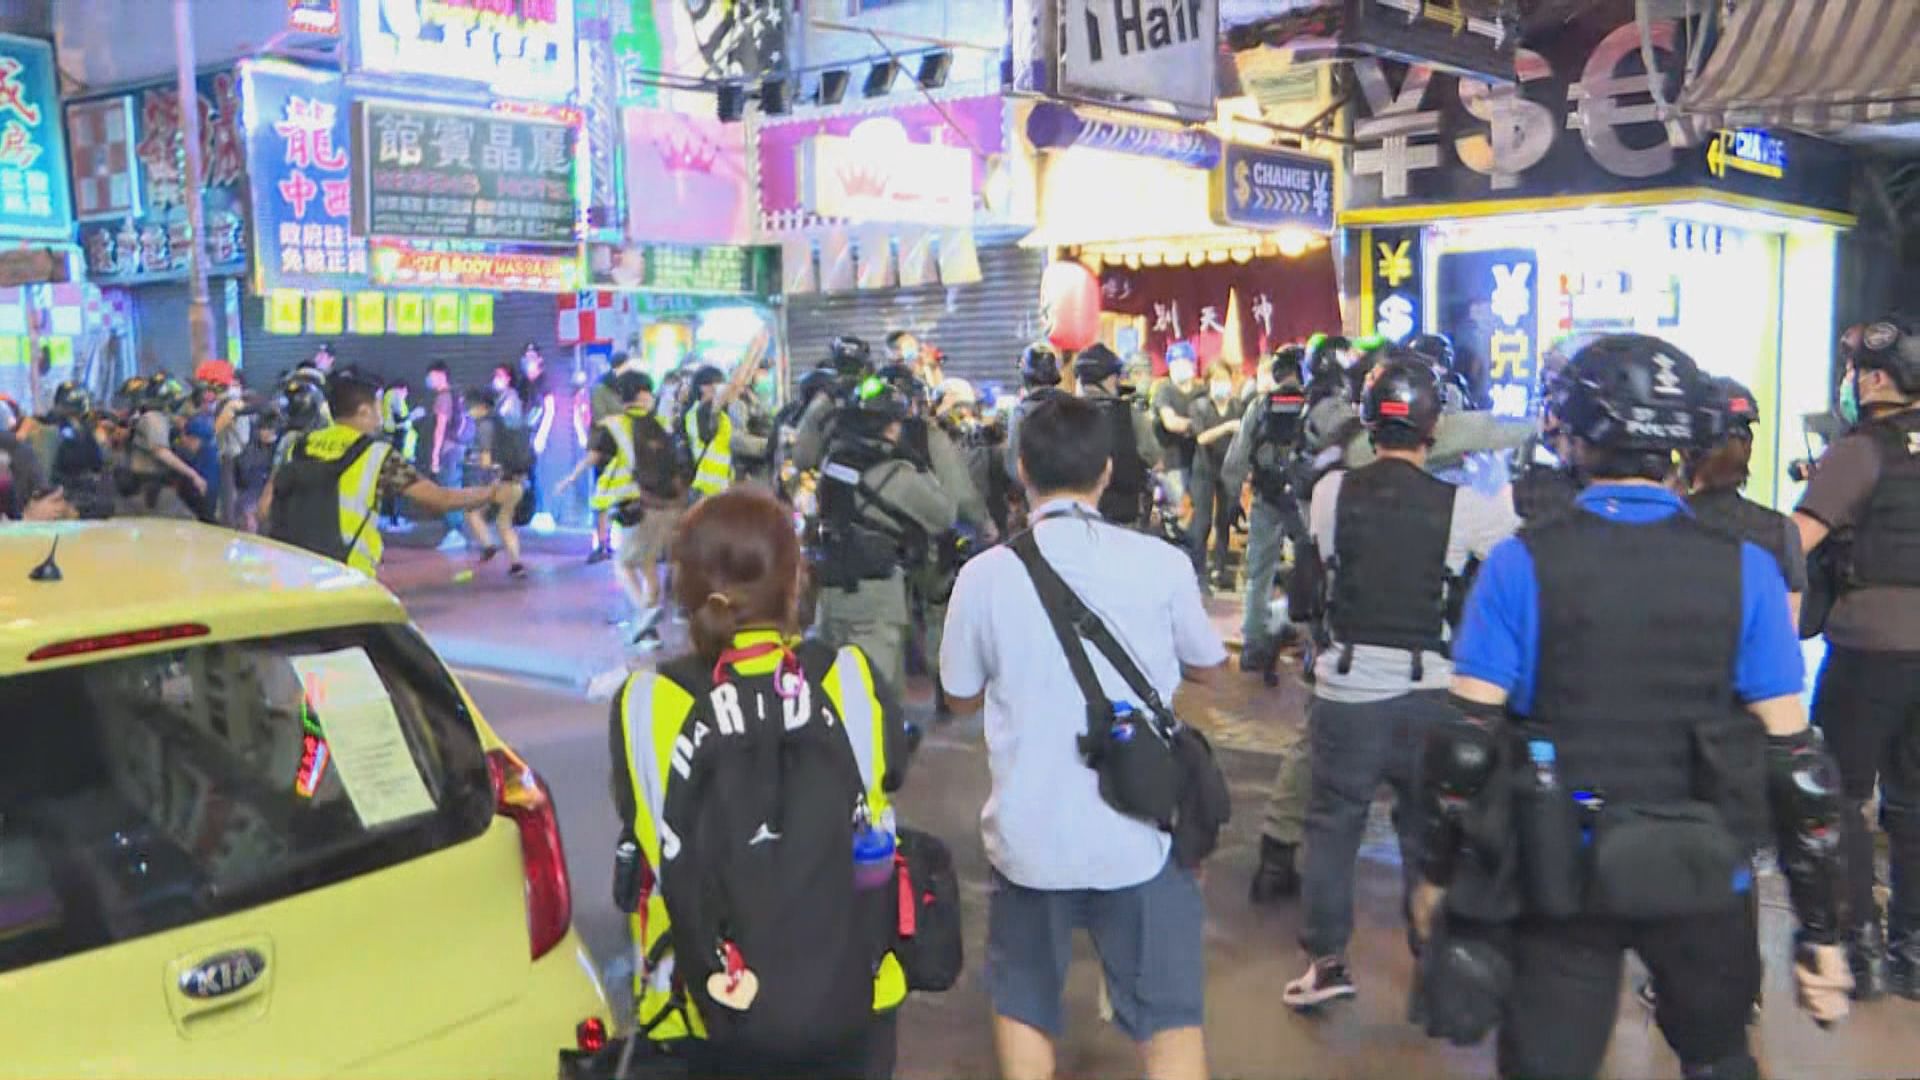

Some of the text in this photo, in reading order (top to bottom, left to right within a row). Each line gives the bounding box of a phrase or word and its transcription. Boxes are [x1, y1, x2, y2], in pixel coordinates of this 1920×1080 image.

[1113, 0, 1200, 55] Hair
[1253, 162, 1311, 191] CHANGE
[197, 952, 257, 994] KIA
